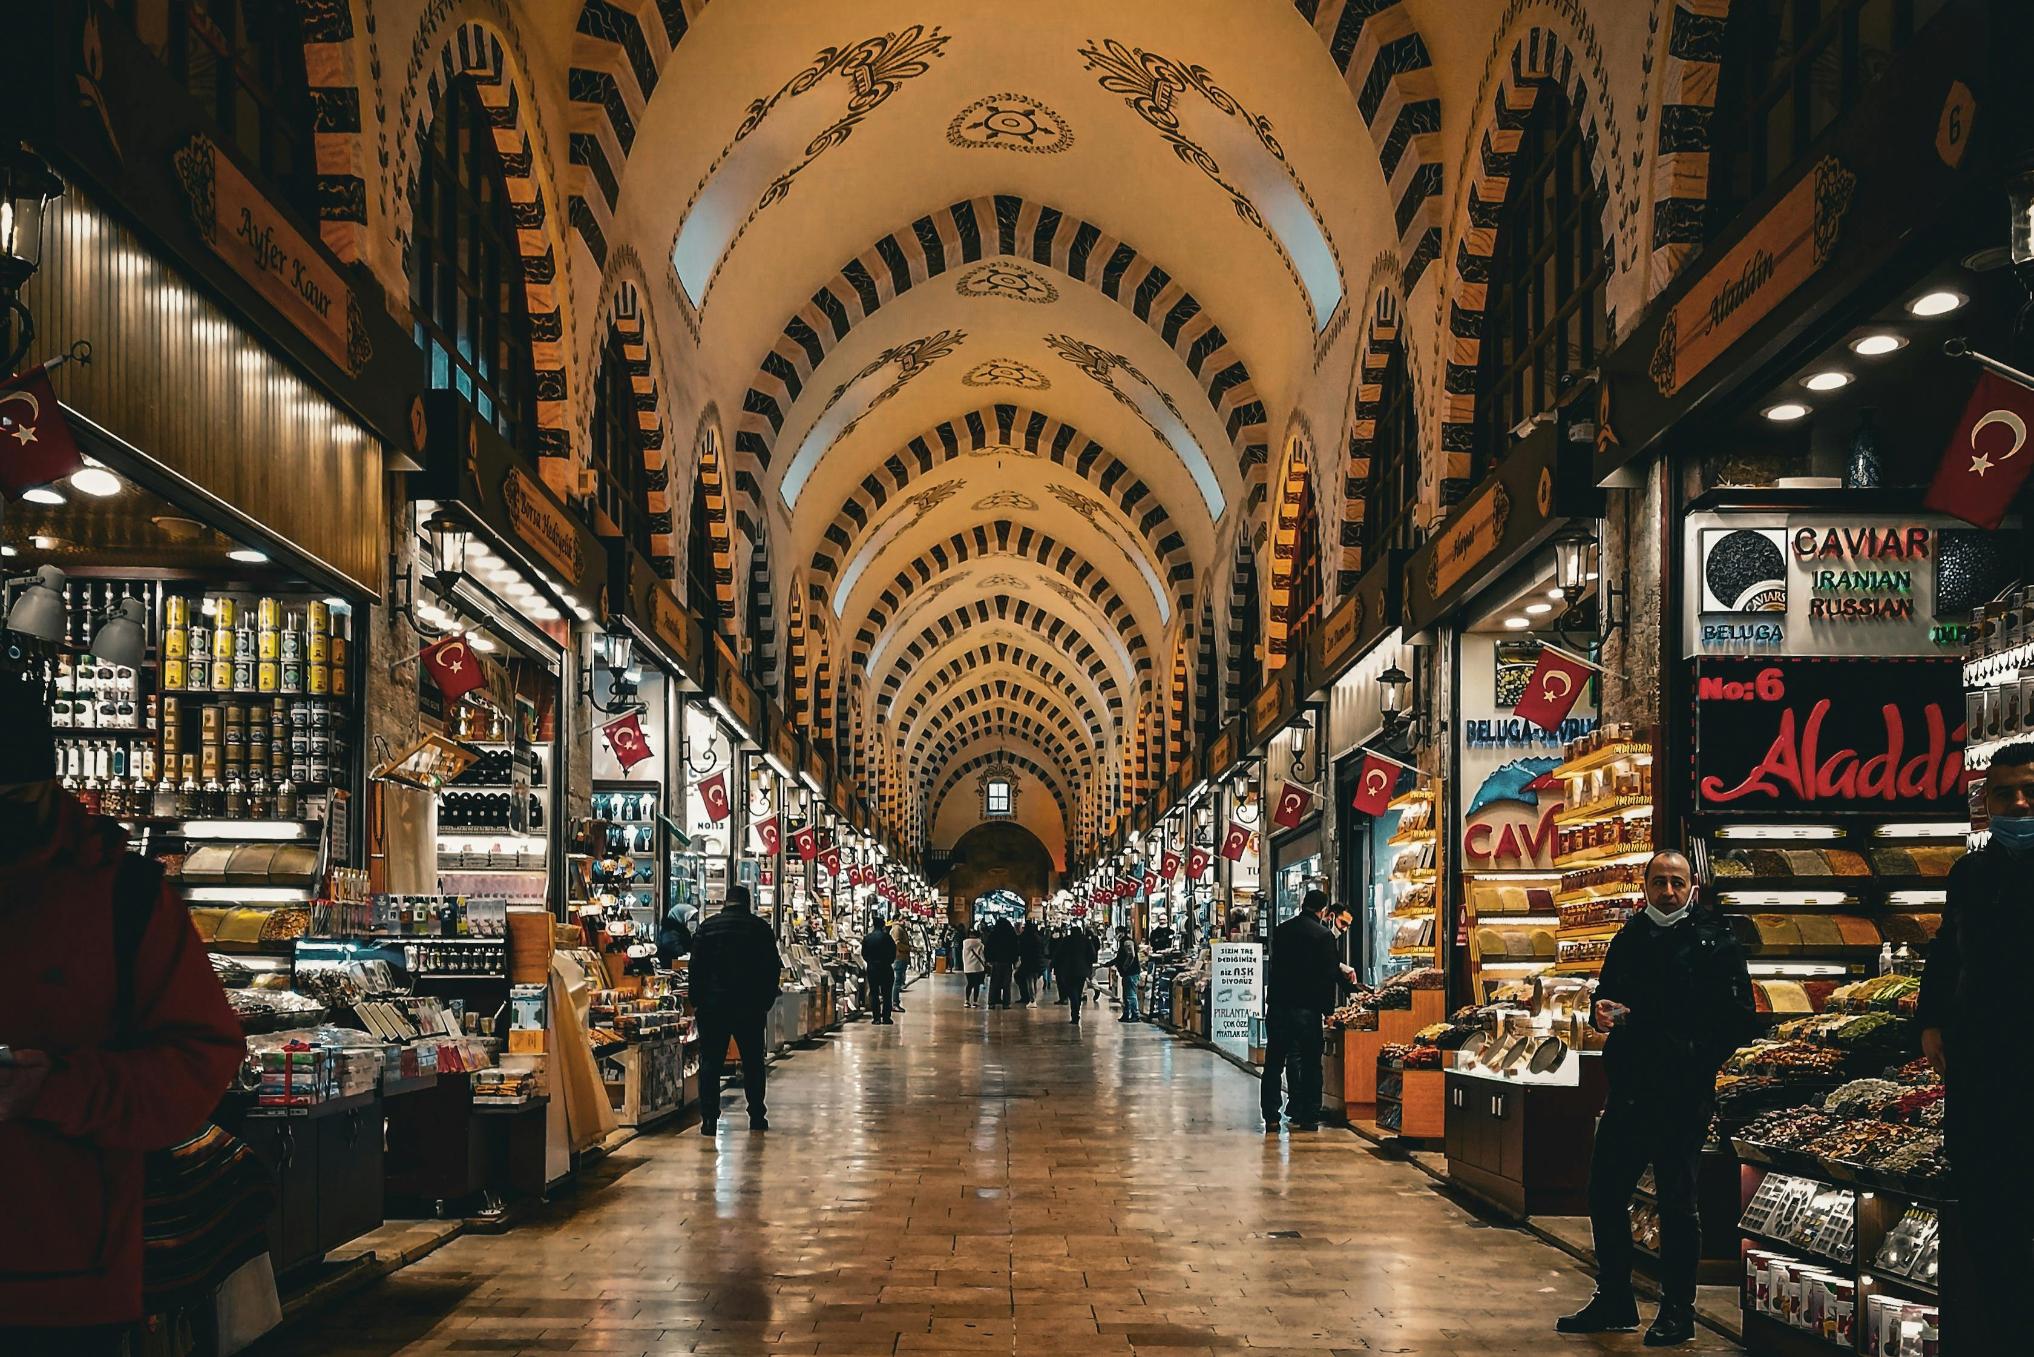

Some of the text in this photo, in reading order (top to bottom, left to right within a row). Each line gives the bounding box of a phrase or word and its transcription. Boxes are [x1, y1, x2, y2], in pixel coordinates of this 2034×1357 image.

[236, 207, 288, 276] Ayfer
[1705, 248, 1775, 336] Aladdin
[415, 410, 423, 435] 7
[1793, 527, 1931, 559] CAVIAR
[1813, 570, 1911, 592] IRANIAN
[1809, 598, 1914, 618] RUSSIAN
[1702, 624, 1784, 642] BELUGA
[1700, 667, 1785, 701] No:6
[1700, 699, 1970, 802] Aladdi
[1233, 967, 1254, 978] AŞK
